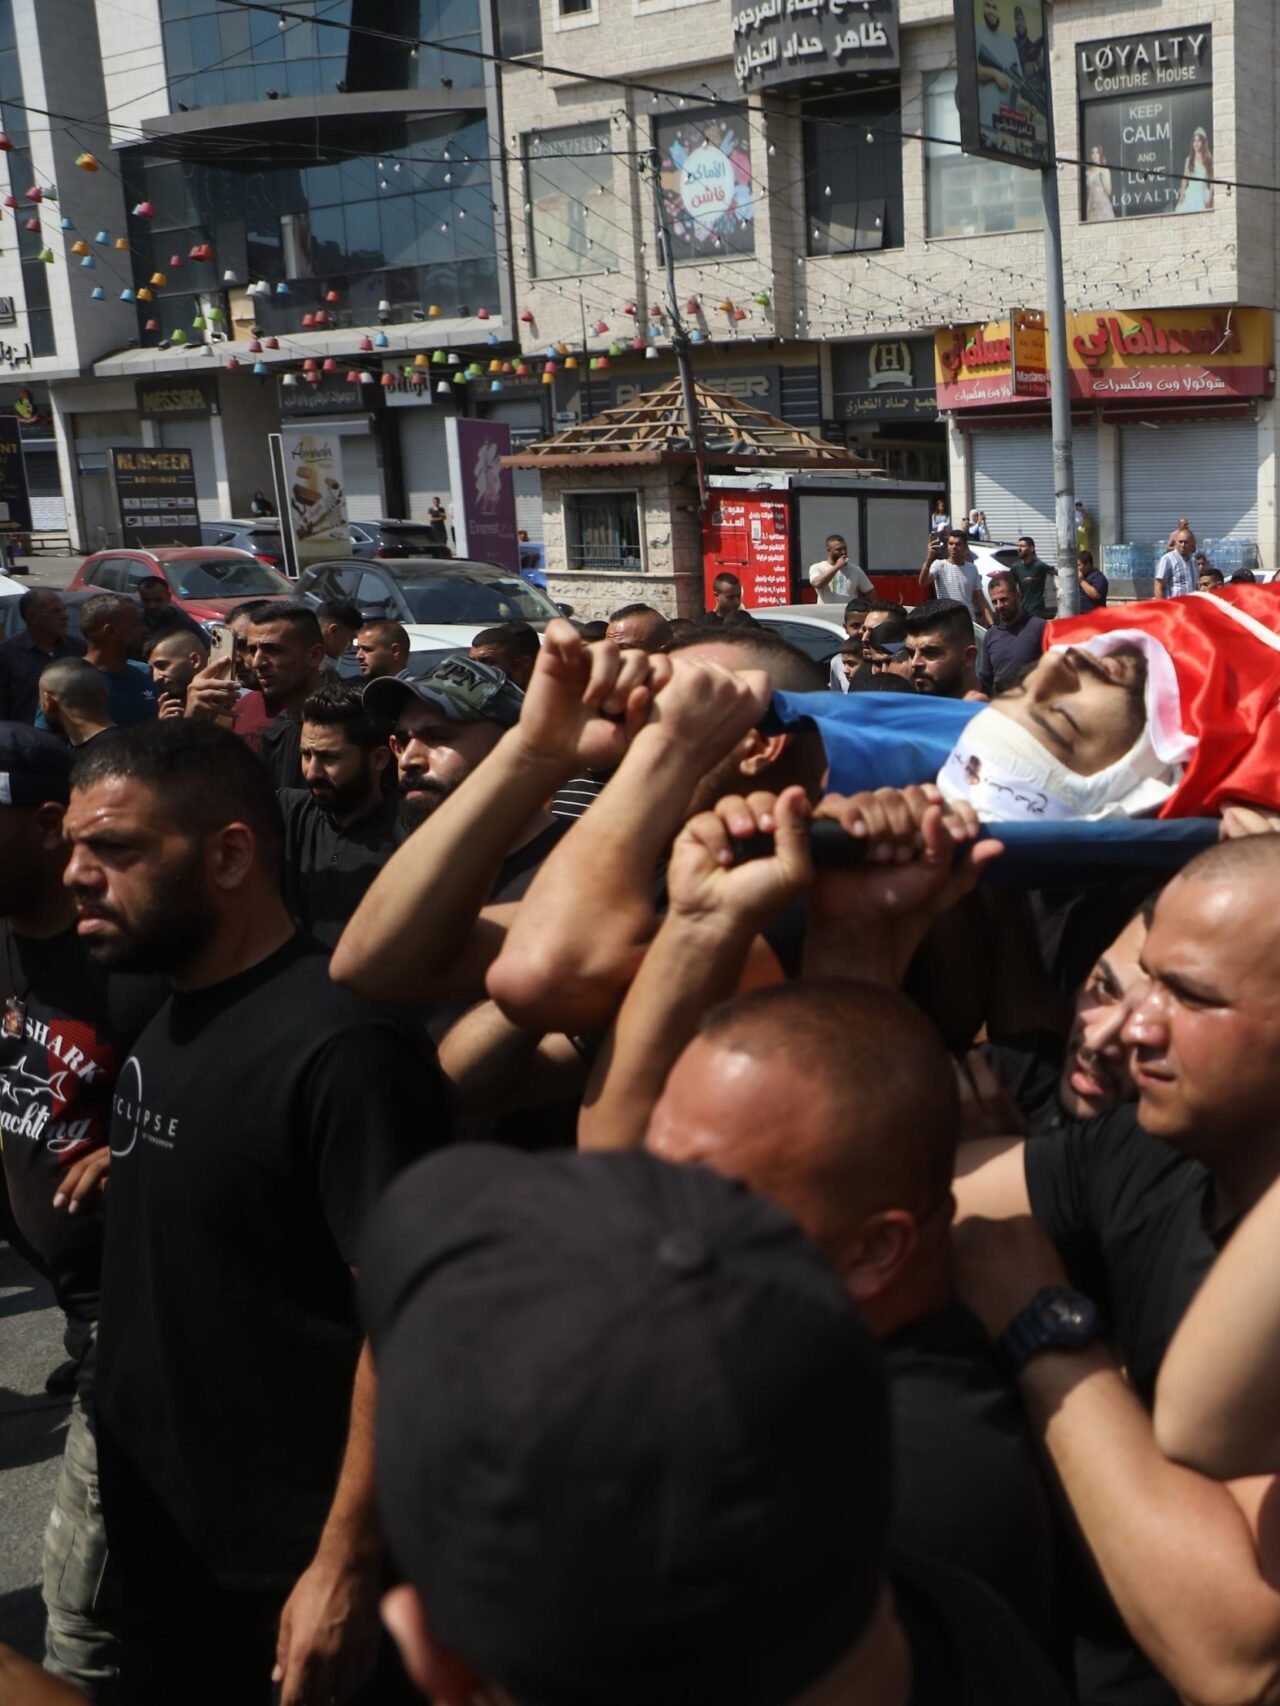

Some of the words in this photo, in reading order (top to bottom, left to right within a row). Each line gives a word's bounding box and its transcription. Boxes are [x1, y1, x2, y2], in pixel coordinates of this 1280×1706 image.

[783, 32, 823, 58] حداد
[832, 22, 887, 57] ظاهر
[734, 36, 777, 88] التجاري
[1081, 33, 1204, 73] LØYALTY
[1094, 72, 1149, 92] COUTURE
[1156, 65, 1196, 83] HOUSE
[1129, 104, 1163, 120] KEEP
[1122, 122, 1170, 144] CALM
[1137, 152, 1156, 163] AND
[1128, 166, 1166, 185] LOVE
[1112, 187, 1181, 206] LØYALTY
[1073, 317, 1242, 366] المسلماني
[879, 344, 900, 370] H
[1092, 371, 1153, 392] ومكسرات
[1183, 370, 1226, 393] شوكولا
[846, 397, 881, 417] التجاري
[914, 397, 937, 412] جمع
[25, 1016, 107, 1084] SHARK
[0, 1101, 92, 1153] achting
